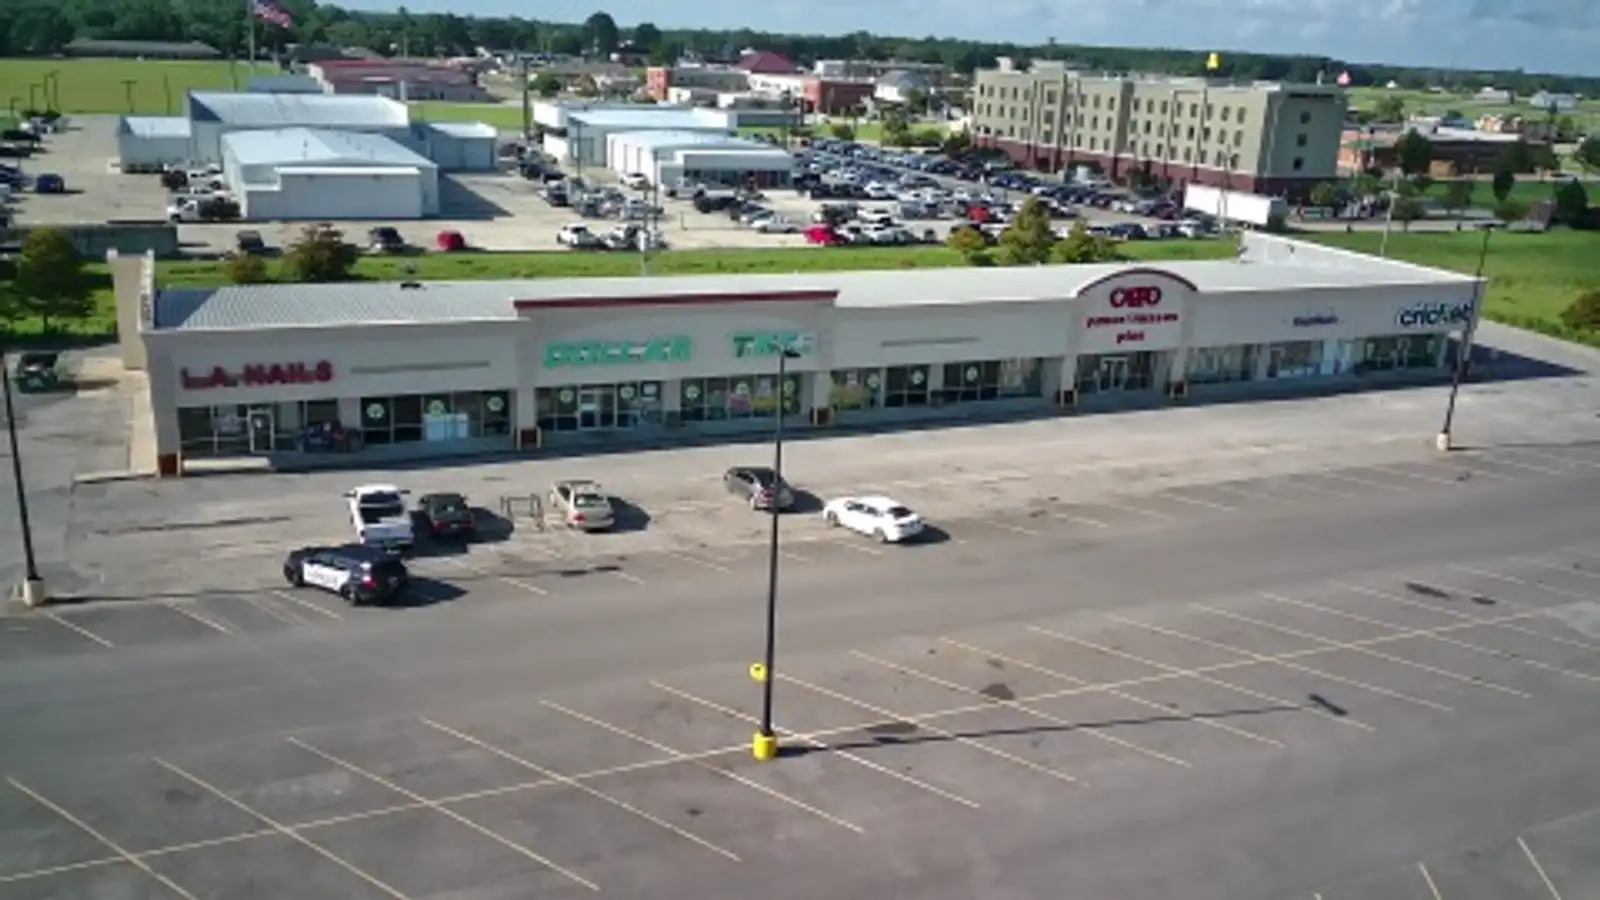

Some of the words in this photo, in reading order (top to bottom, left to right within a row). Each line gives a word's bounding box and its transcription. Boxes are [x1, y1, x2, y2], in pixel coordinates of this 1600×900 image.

[1109, 286, 1162, 309] CATO
[542, 335, 692, 369] DOLLAR
[243, 358, 333, 386] NAILS
